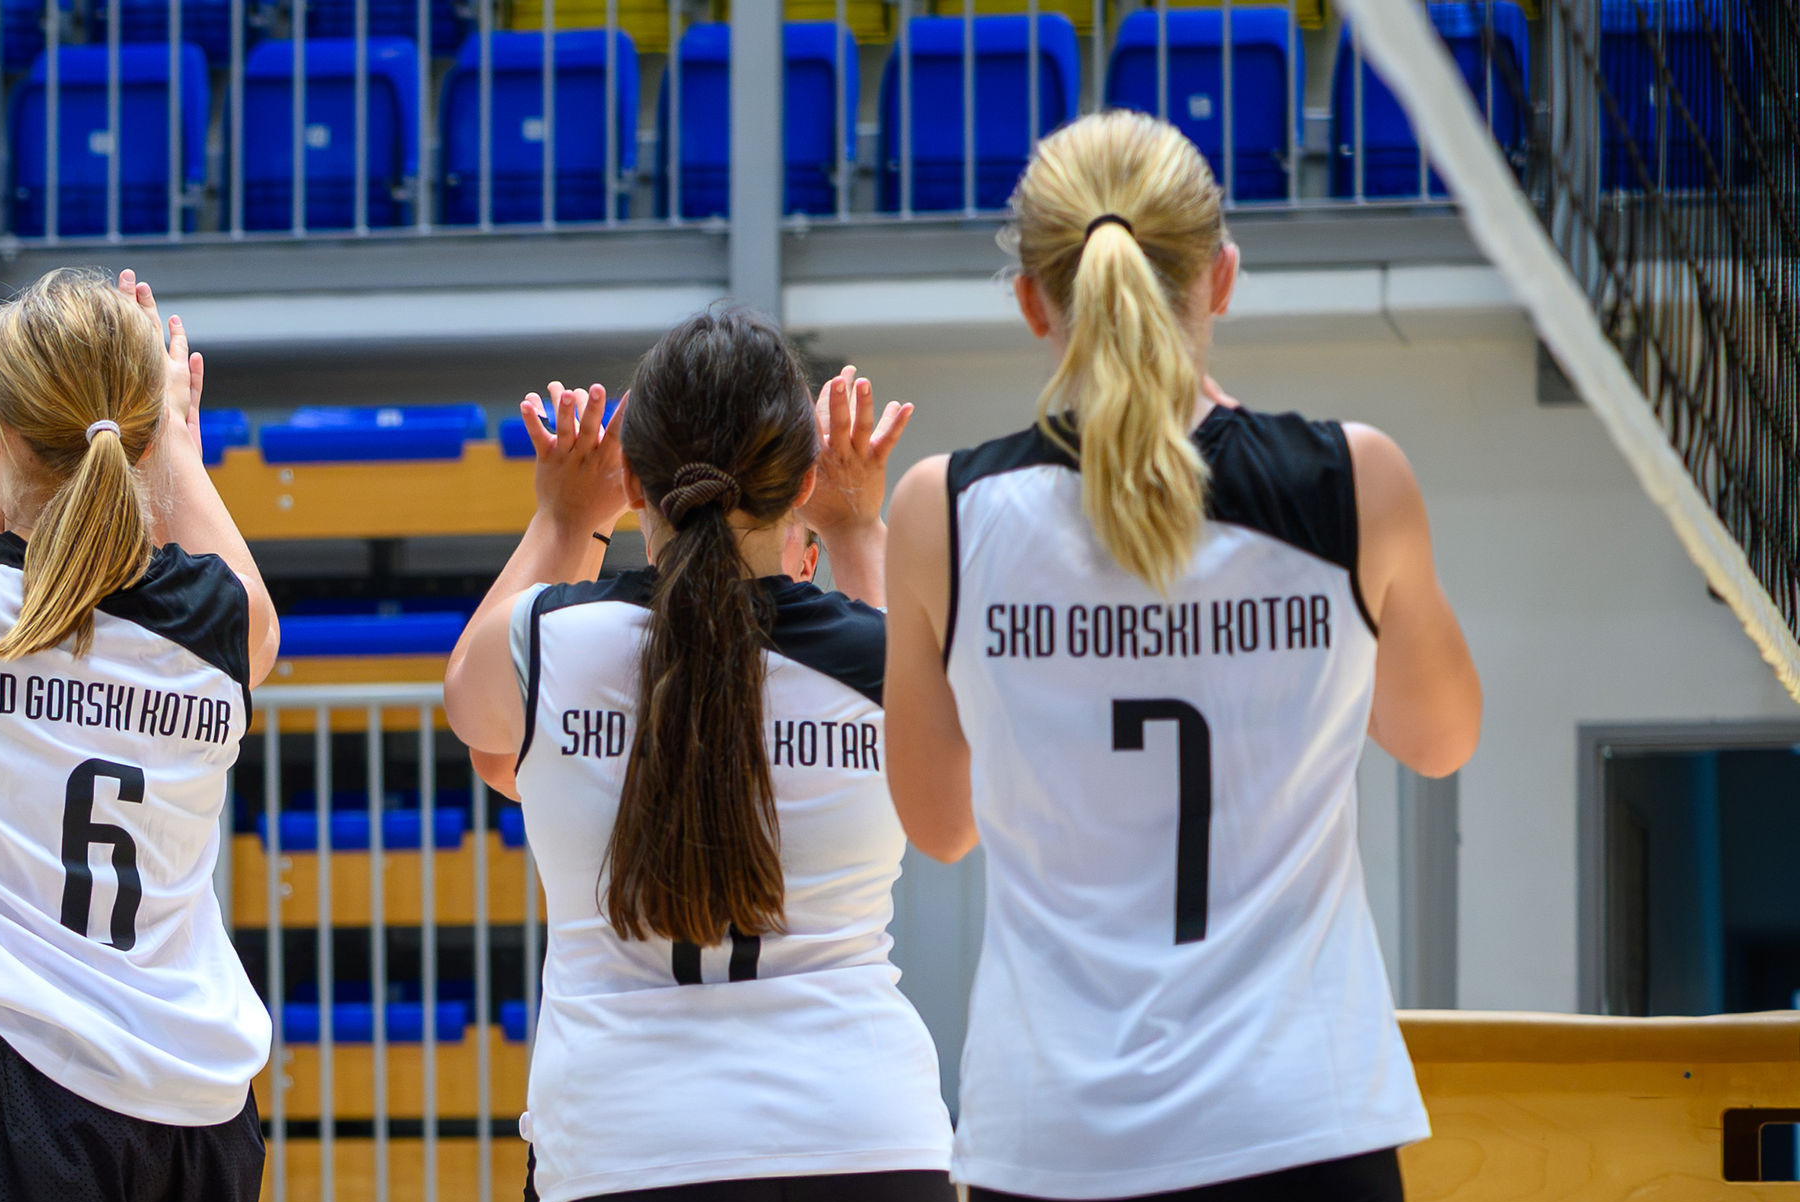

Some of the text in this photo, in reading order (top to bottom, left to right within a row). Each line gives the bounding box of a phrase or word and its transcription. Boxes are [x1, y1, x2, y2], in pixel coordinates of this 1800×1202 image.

[987, 594, 1331, 659] SKD GORSKI KOTAR
[26, 675, 135, 732] GORSKI
[139, 689, 231, 745] KOTAR
[561, 709, 880, 771] SKD KOTAR
[61, 757, 145, 951] 6
[1111, 698, 1213, 946] 7
